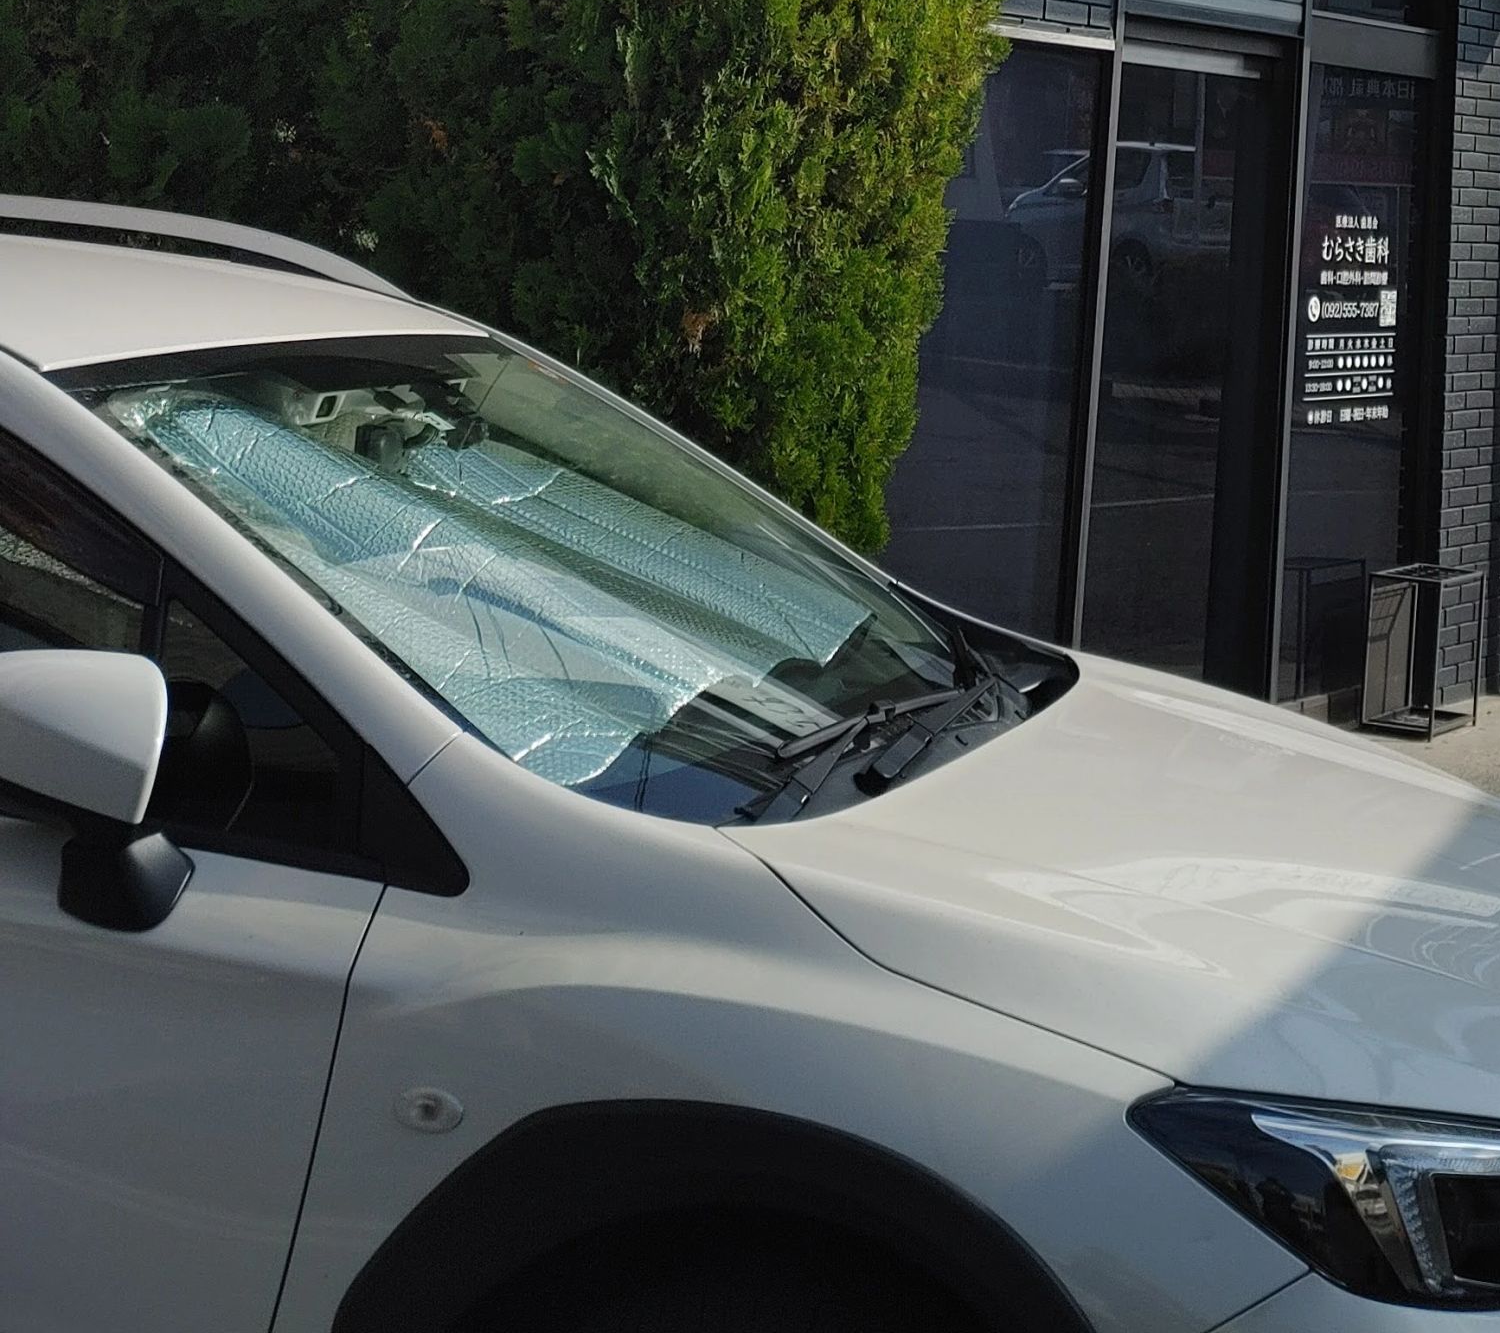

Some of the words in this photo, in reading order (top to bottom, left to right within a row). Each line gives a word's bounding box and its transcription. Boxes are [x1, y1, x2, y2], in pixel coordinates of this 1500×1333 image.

[1321, 234, 1390, 265] むらさき歯科
[1321, 301, 1379, 319] (092)555-7387
